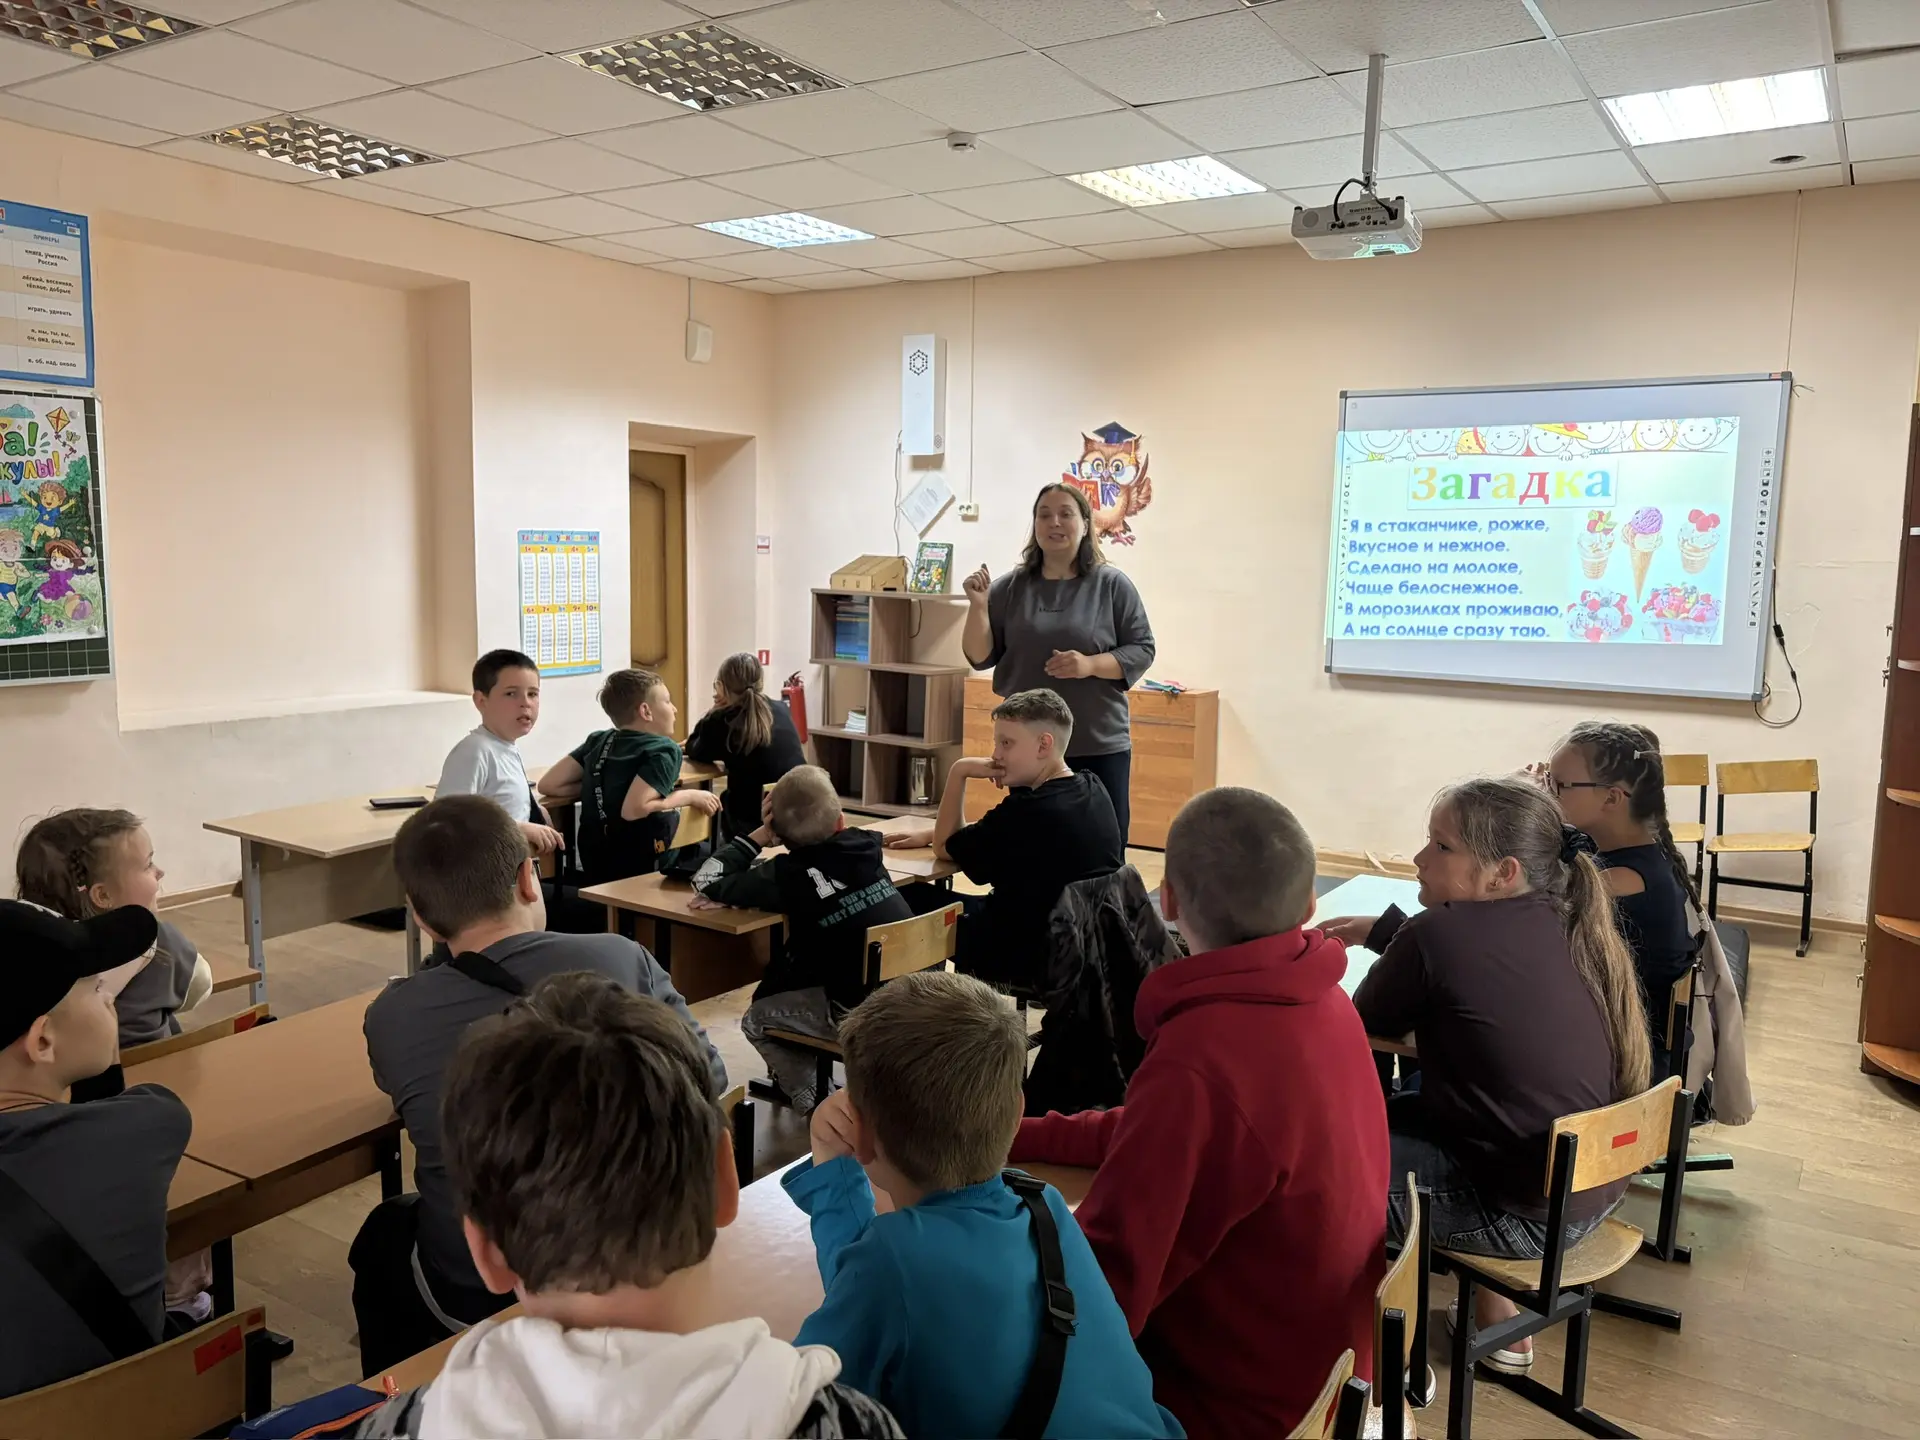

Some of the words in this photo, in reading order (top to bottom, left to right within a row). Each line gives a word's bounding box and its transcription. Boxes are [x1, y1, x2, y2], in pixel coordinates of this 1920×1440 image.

[33, 234, 60, 244] ПРИМЕРЫ
[38, 259, 58, 267] Россия
[1411, 466, 1612, 506] Загадка
[1350, 519, 1359, 532] Я
[1364, 522, 1372, 532] в
[1377, 520, 1482, 533] стаканчике,
[1488, 519, 1549, 534] рожке,
[1349, 540, 1418, 557] Вкусное
[1423, 541, 1433, 552] и
[1439, 541, 1510, 552] нежное.
[1347, 561, 1422, 575] Сделано
[1427, 562, 1448, 573] на
[1452, 562, 1523, 575] молоке,
[1346, 581, 1393, 595] Чаще
[1398, 580, 1523, 595] белоснежное.
[1345, 602, 1353, 615] В
[1358, 604, 1460, 619] морозилках
[1466, 604, 1563, 619] проживаю,
[1343, 622, 1354, 636] А
[1360, 625, 1380, 636] на
[1385, 625, 1448, 637] солнце
[1453, 625, 1505, 640] сразу
[1510, 626, 1550, 637] таю.
